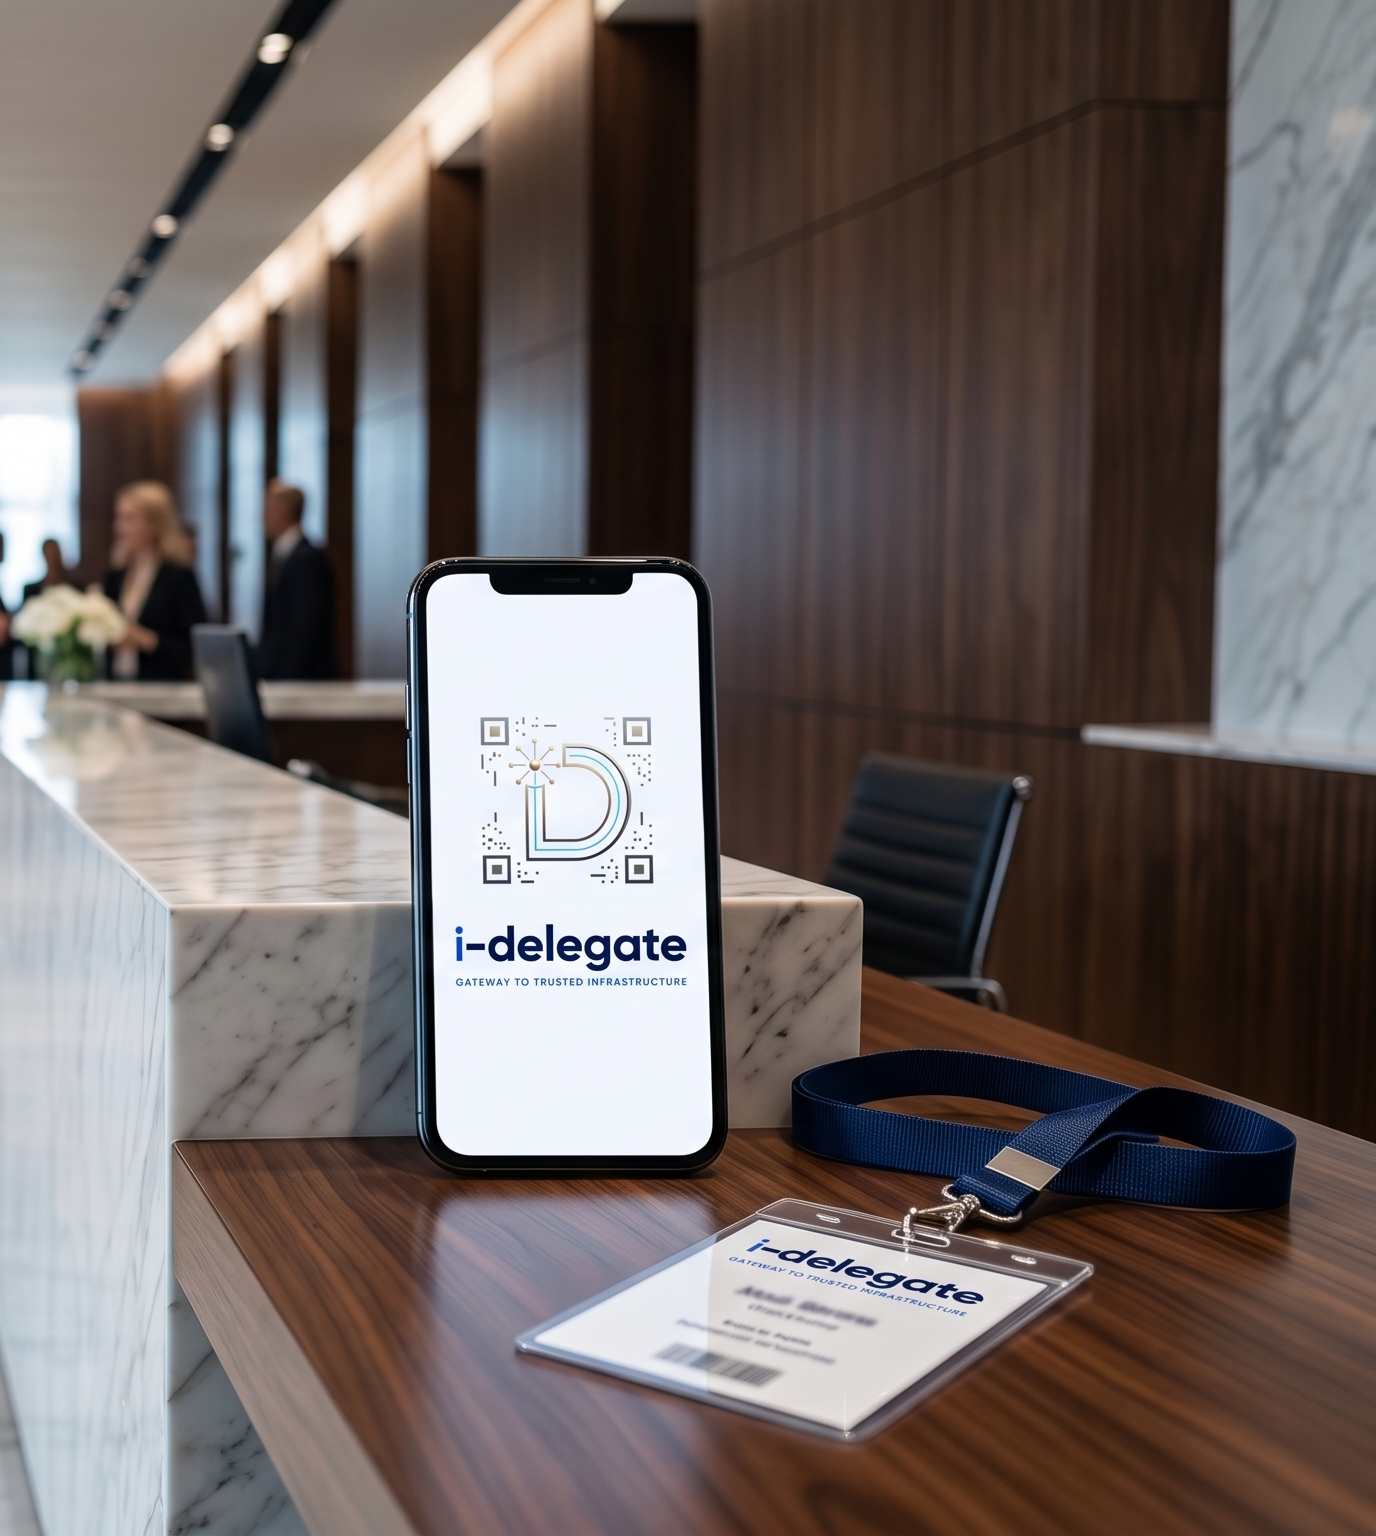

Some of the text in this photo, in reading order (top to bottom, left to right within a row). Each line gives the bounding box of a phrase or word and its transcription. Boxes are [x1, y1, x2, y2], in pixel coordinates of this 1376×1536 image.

[455, 923, 687, 972] i-delegate
[455, 977, 688, 987] GATEWAY TO TRUSTED INFRASTRUCTURE
[746, 1238, 984, 1305] i-delegate
[788, 1270, 804, 1278] TO
